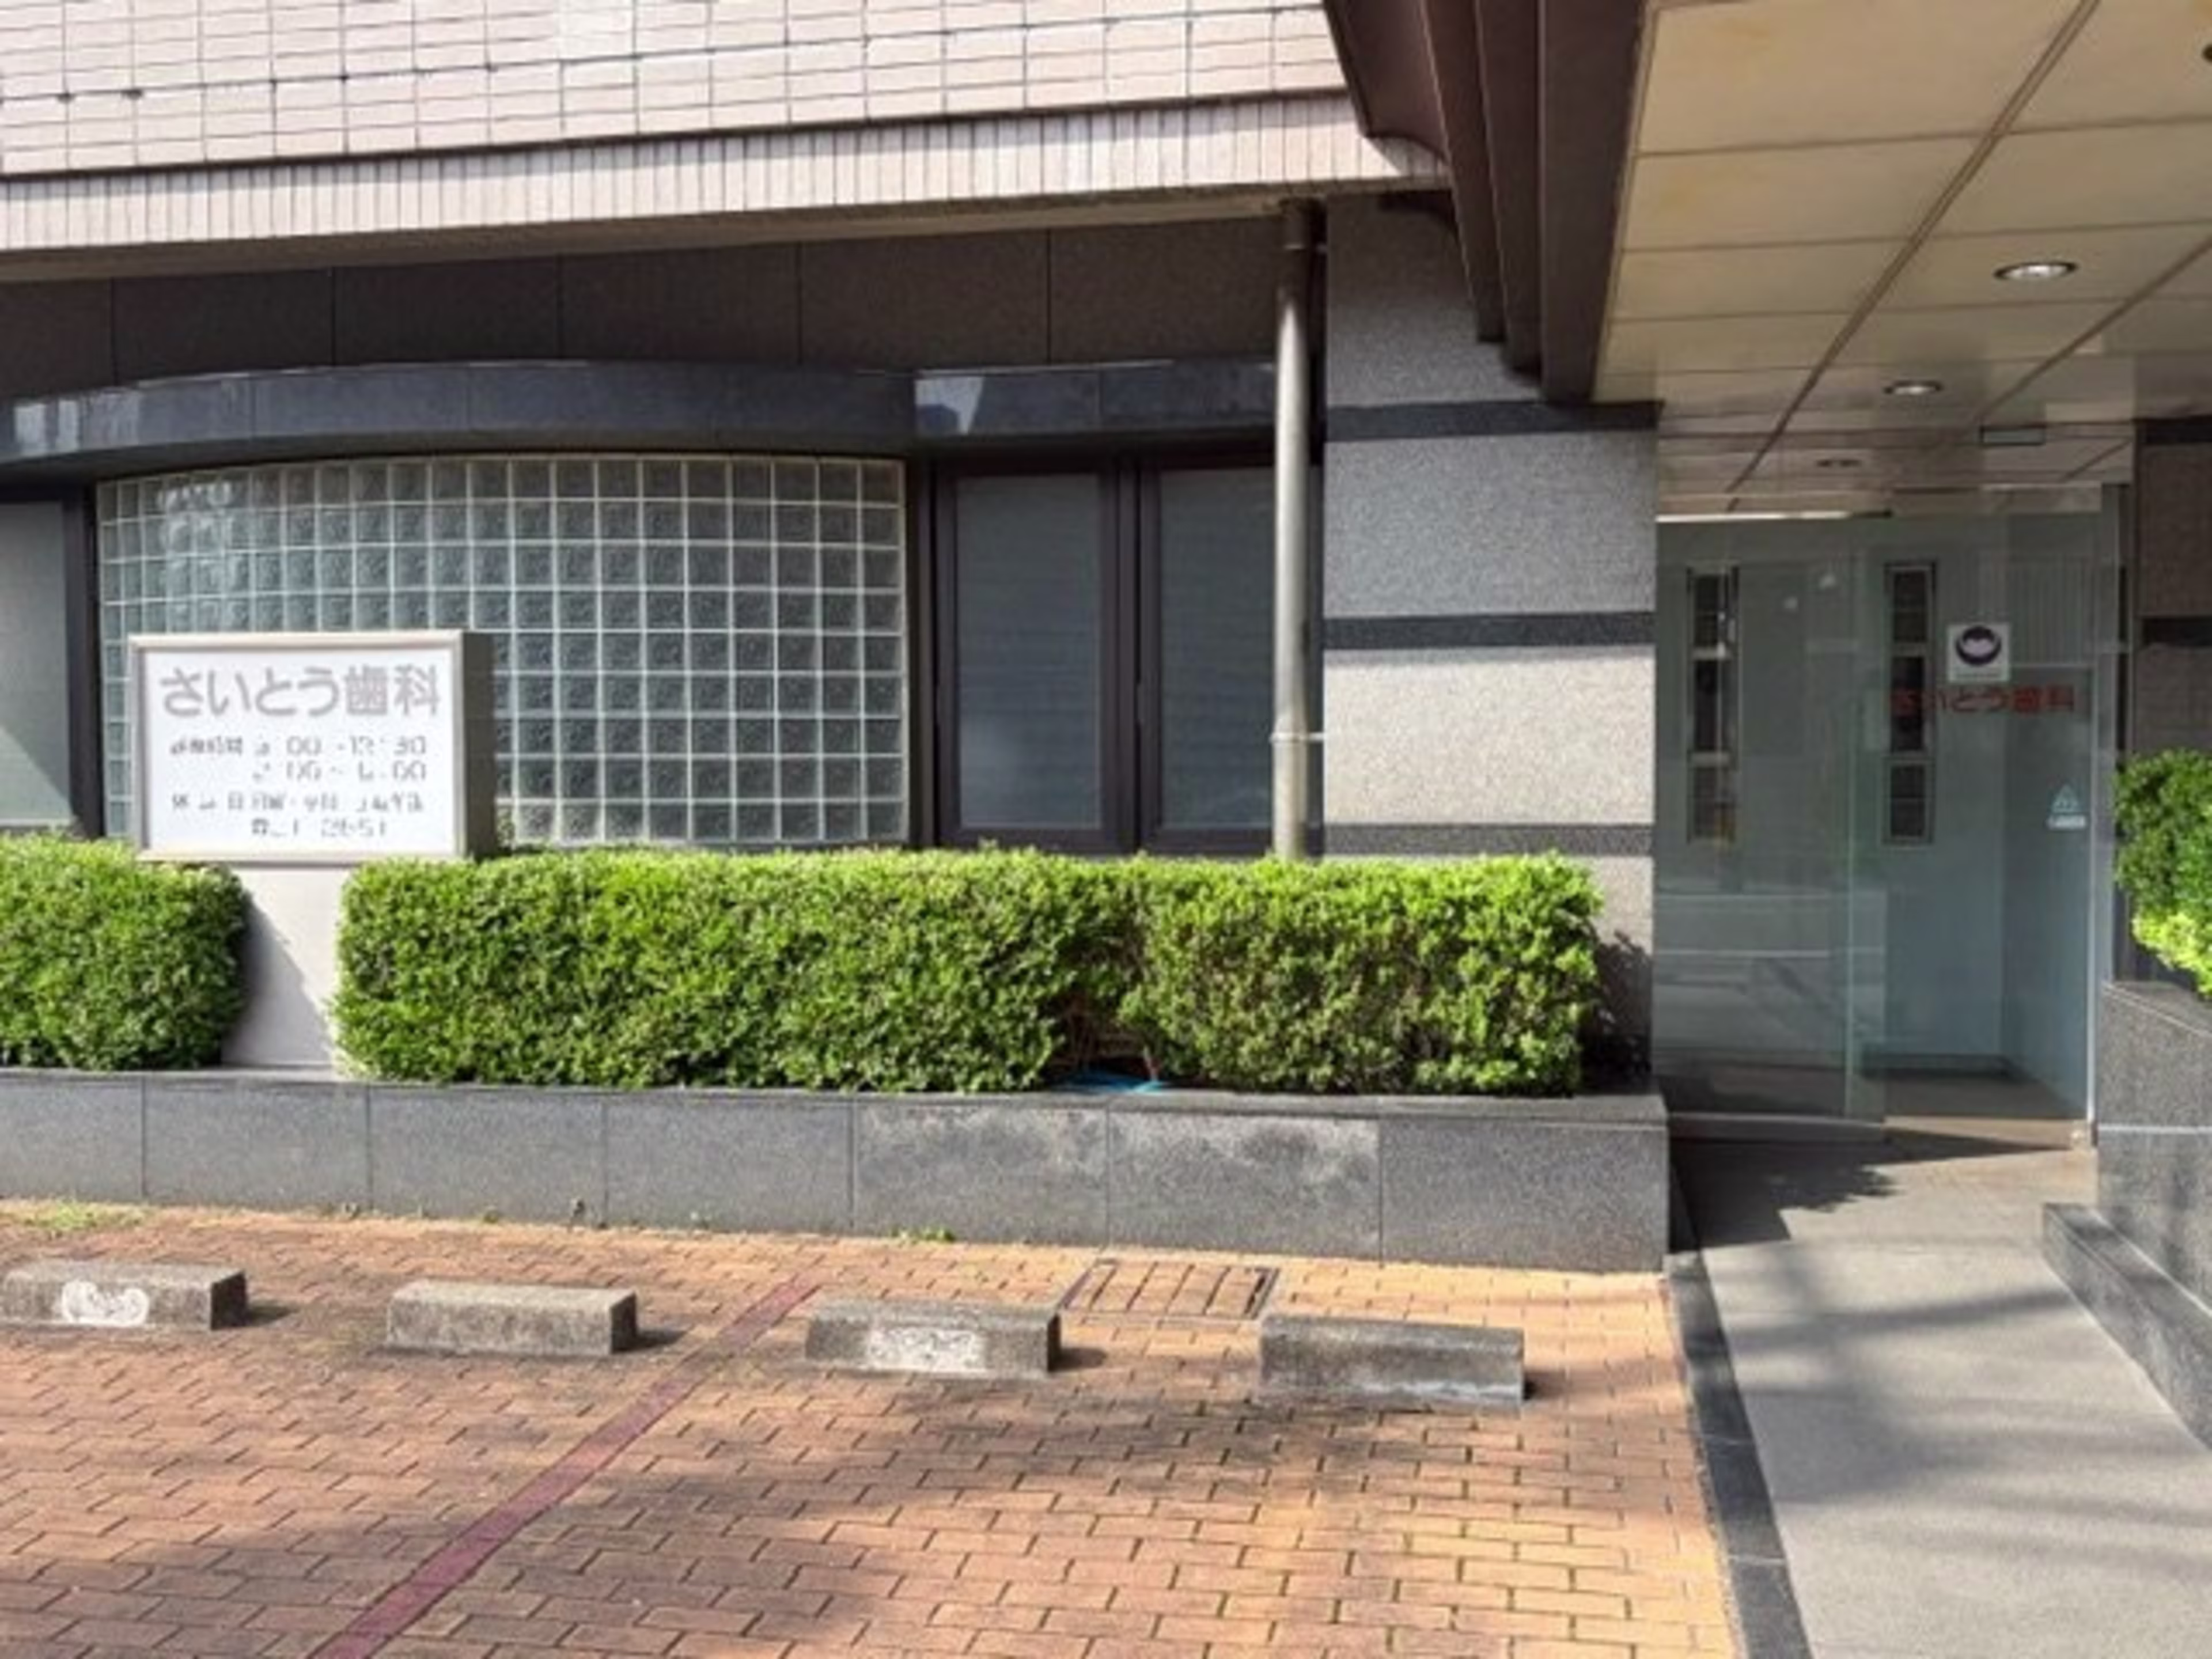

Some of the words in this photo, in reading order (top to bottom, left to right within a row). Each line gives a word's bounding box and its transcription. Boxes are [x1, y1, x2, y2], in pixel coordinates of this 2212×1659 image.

[160, 664, 439, 718] さいとう歯科
